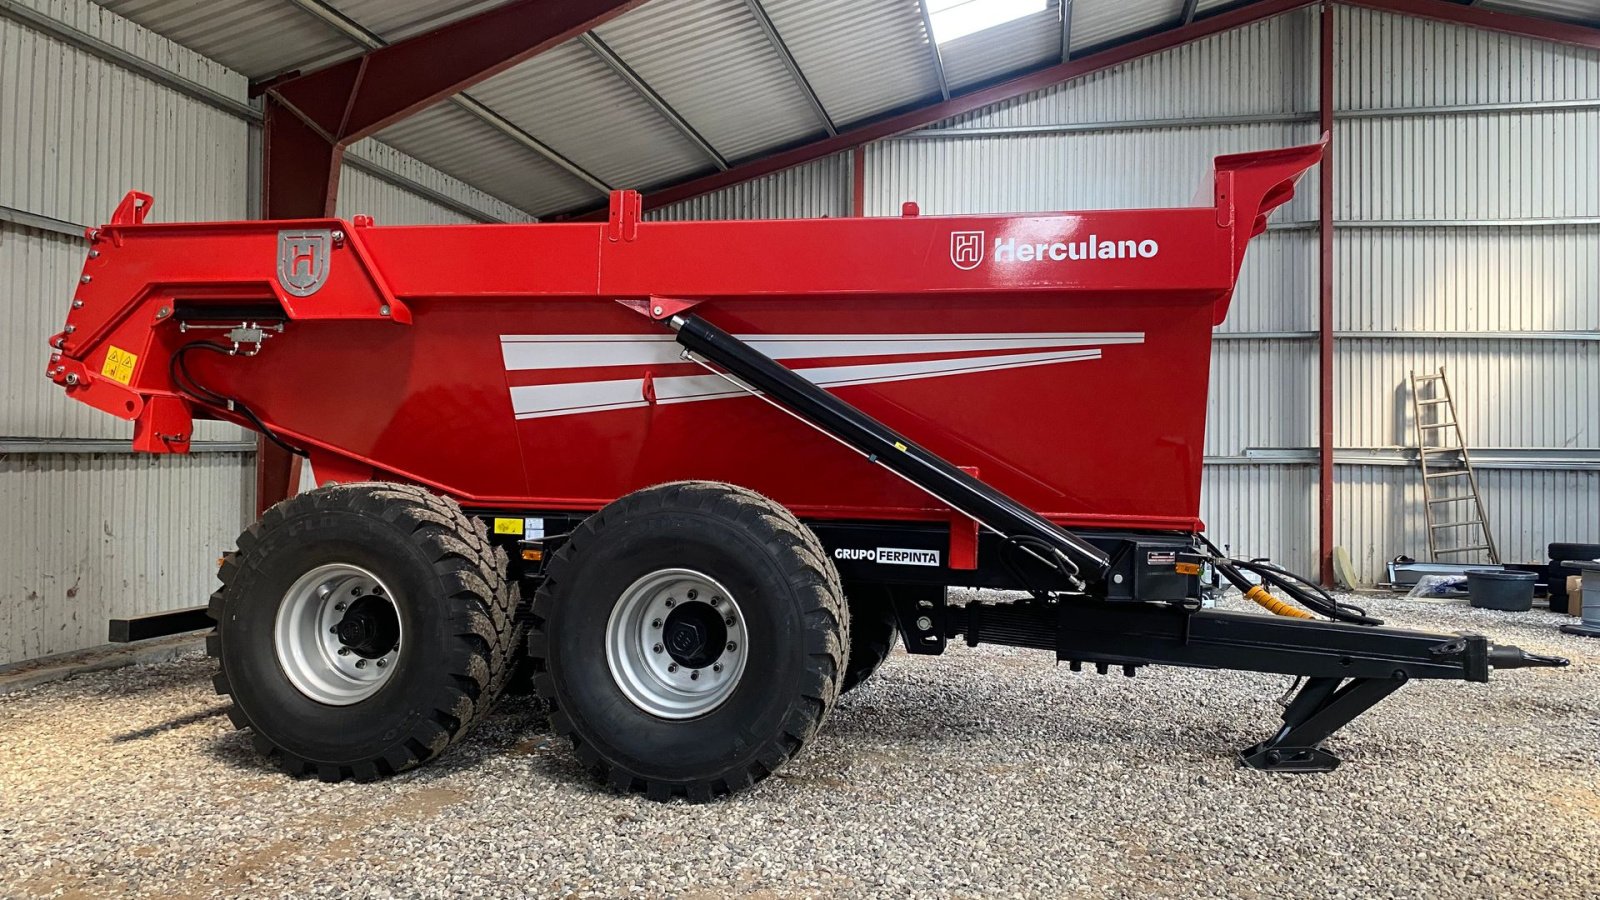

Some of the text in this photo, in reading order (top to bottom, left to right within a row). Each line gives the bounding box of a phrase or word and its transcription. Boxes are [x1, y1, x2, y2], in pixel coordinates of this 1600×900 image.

[994, 234, 1159, 262] Herculano
[834, 548, 938, 564] GRUPO FERPINTA
